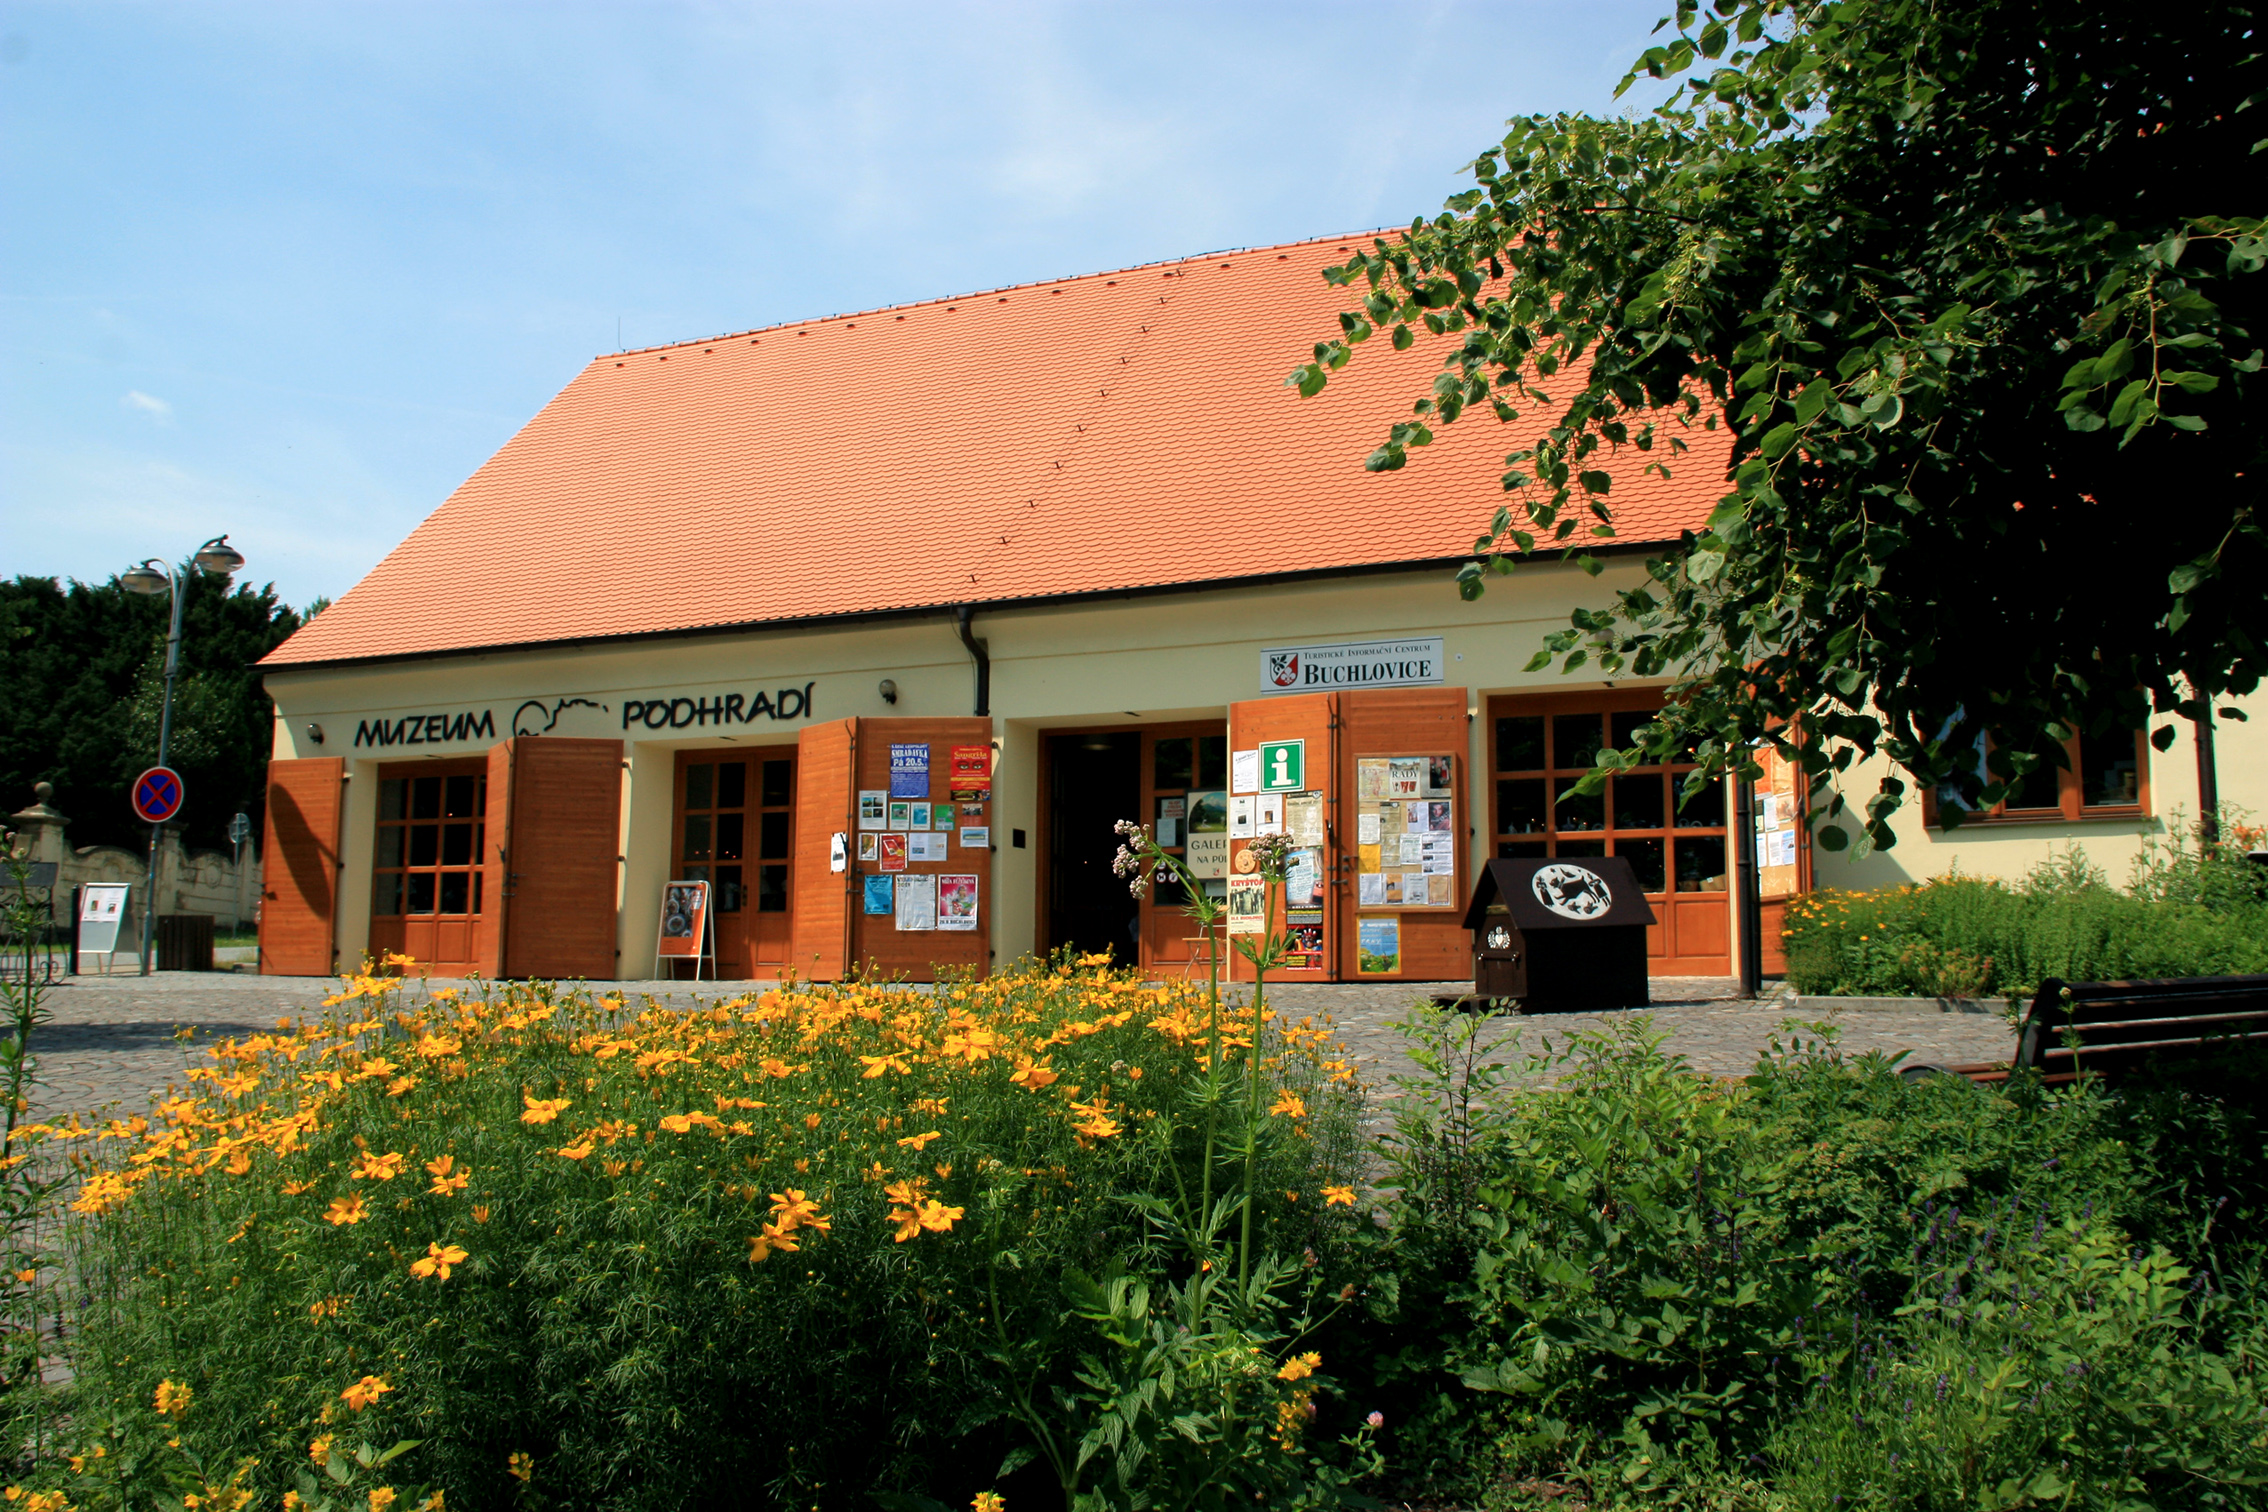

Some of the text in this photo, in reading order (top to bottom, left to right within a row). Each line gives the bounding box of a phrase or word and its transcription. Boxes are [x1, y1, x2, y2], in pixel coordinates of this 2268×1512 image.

[1304, 644, 1431, 660] TURISTICKÉ INFORMAČNÍ CENTRUM
[1304, 660, 1432, 685] BUCHLOVICE
[354, 682, 816, 747] MUZEUM PODHRADÍ
[893, 757, 925, 767] Pá 20.5.
[1212, 854, 1227, 863] PŮ
